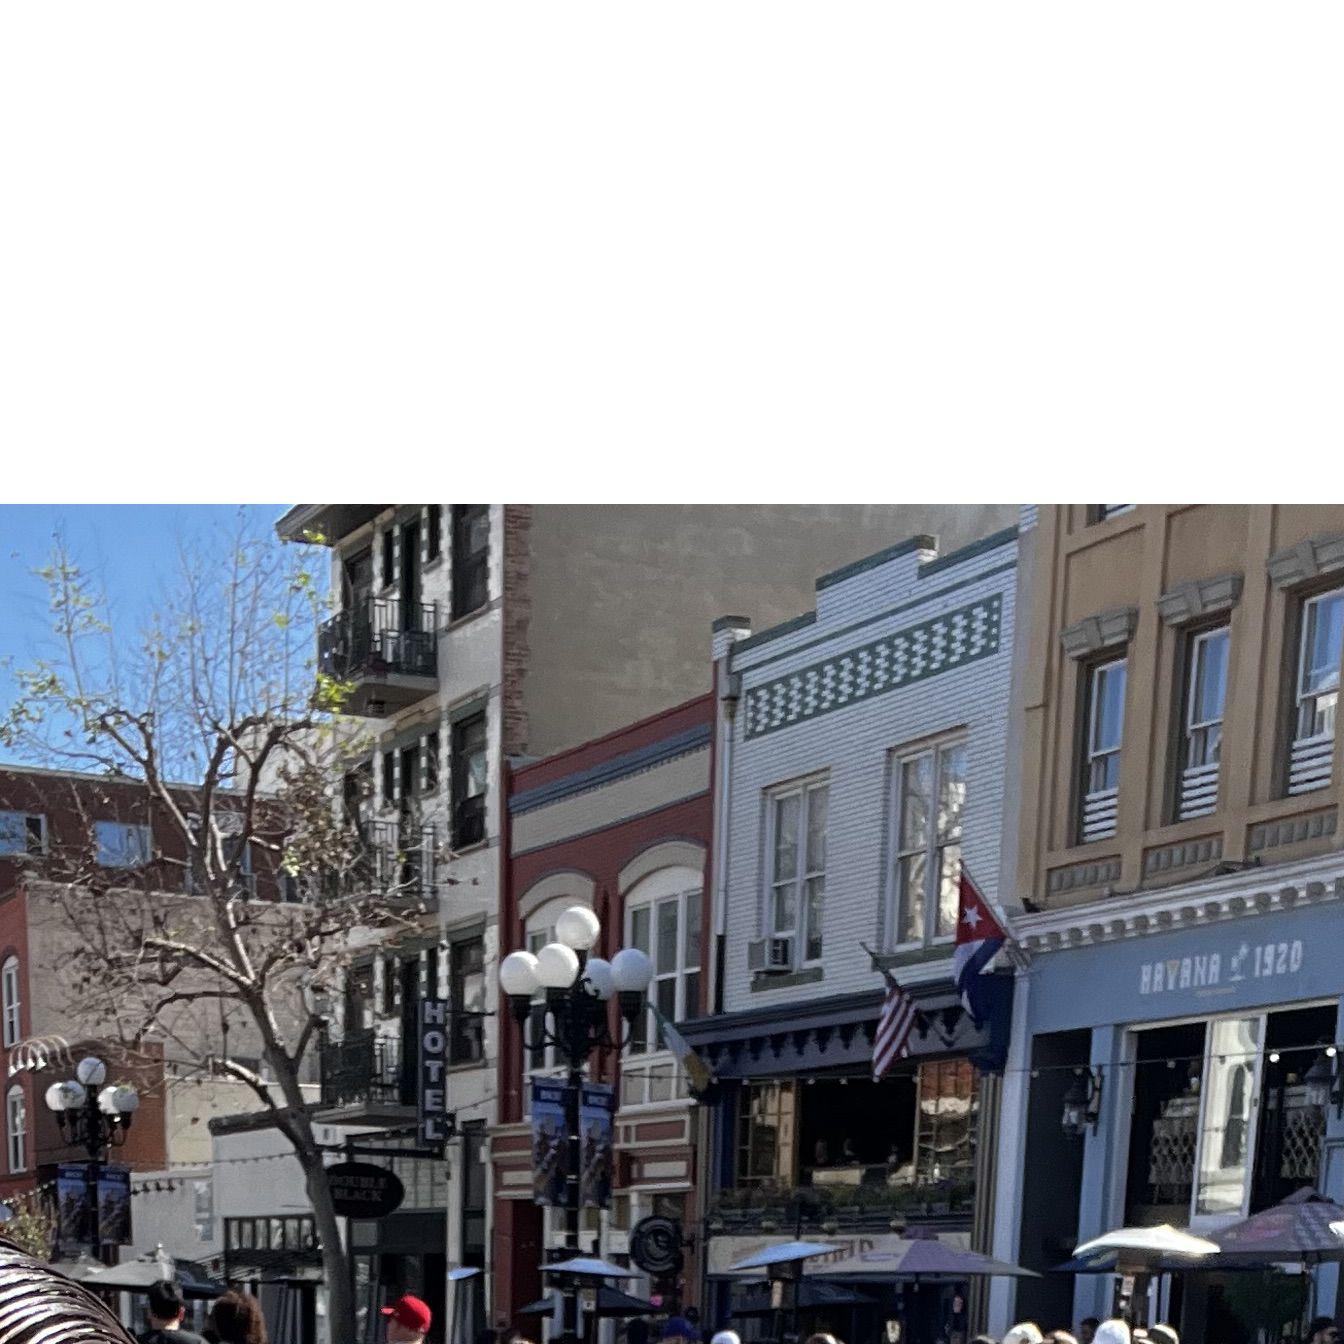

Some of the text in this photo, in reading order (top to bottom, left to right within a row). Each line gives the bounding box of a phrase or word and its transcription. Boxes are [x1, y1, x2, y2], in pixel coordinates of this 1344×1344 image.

[1139, 940, 1303, 995] HAVANA 1920
[423, 1001, 445, 1141] HOTEL
